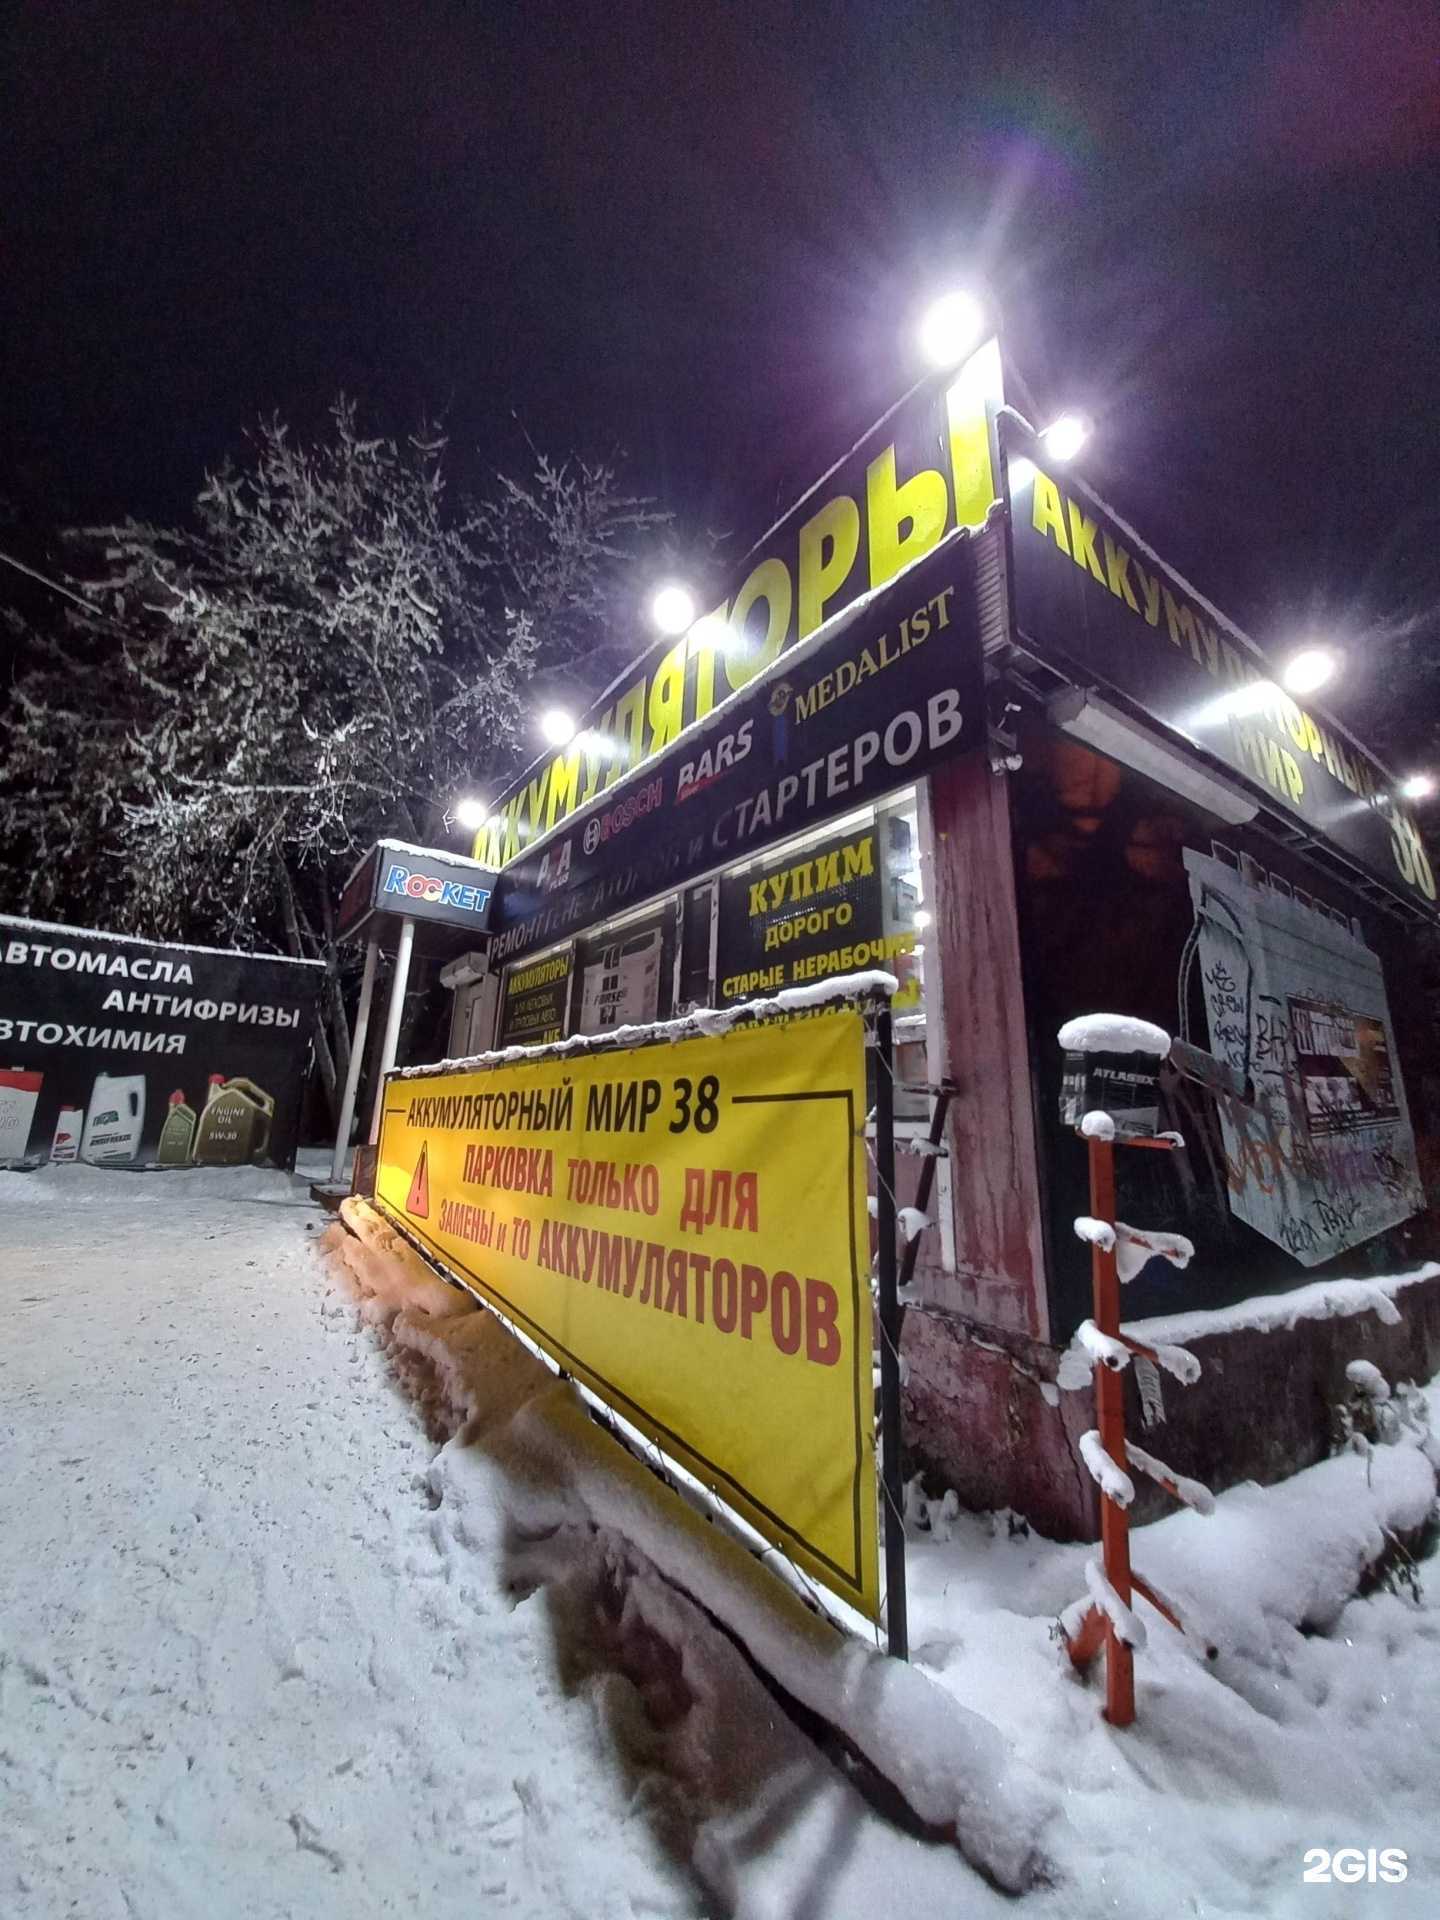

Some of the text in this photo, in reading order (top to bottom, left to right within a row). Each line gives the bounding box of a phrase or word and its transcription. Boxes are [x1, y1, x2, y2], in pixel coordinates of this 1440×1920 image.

[794, 586, 954, 725] MEDALIST
[677, 719, 754, 795] BARS
[711, 688, 963, 847] СТАРТЕРОВ
[384, 864, 491, 912] ROCKET
[748, 836, 875, 917] КУПИМ
[765, 903, 853, 951] ДОРОГО
[0, 940, 194, 985] ВТОМАСЛА
[722, 964, 785, 998] СТАРЫЕ
[102, 988, 300, 1028] АНТИФРИЗЫ
[406, 1074, 720, 1135] АККУМУЛЯТОРНЫЙ МИР 38
[461, 1144, 759, 1235] ПАРКОВКА ТОЛЬКО ДЛЯ
[438, 1198, 843, 1367] ЗАМЕНЫ и ТО АККУМУЛЯТОРОВ
